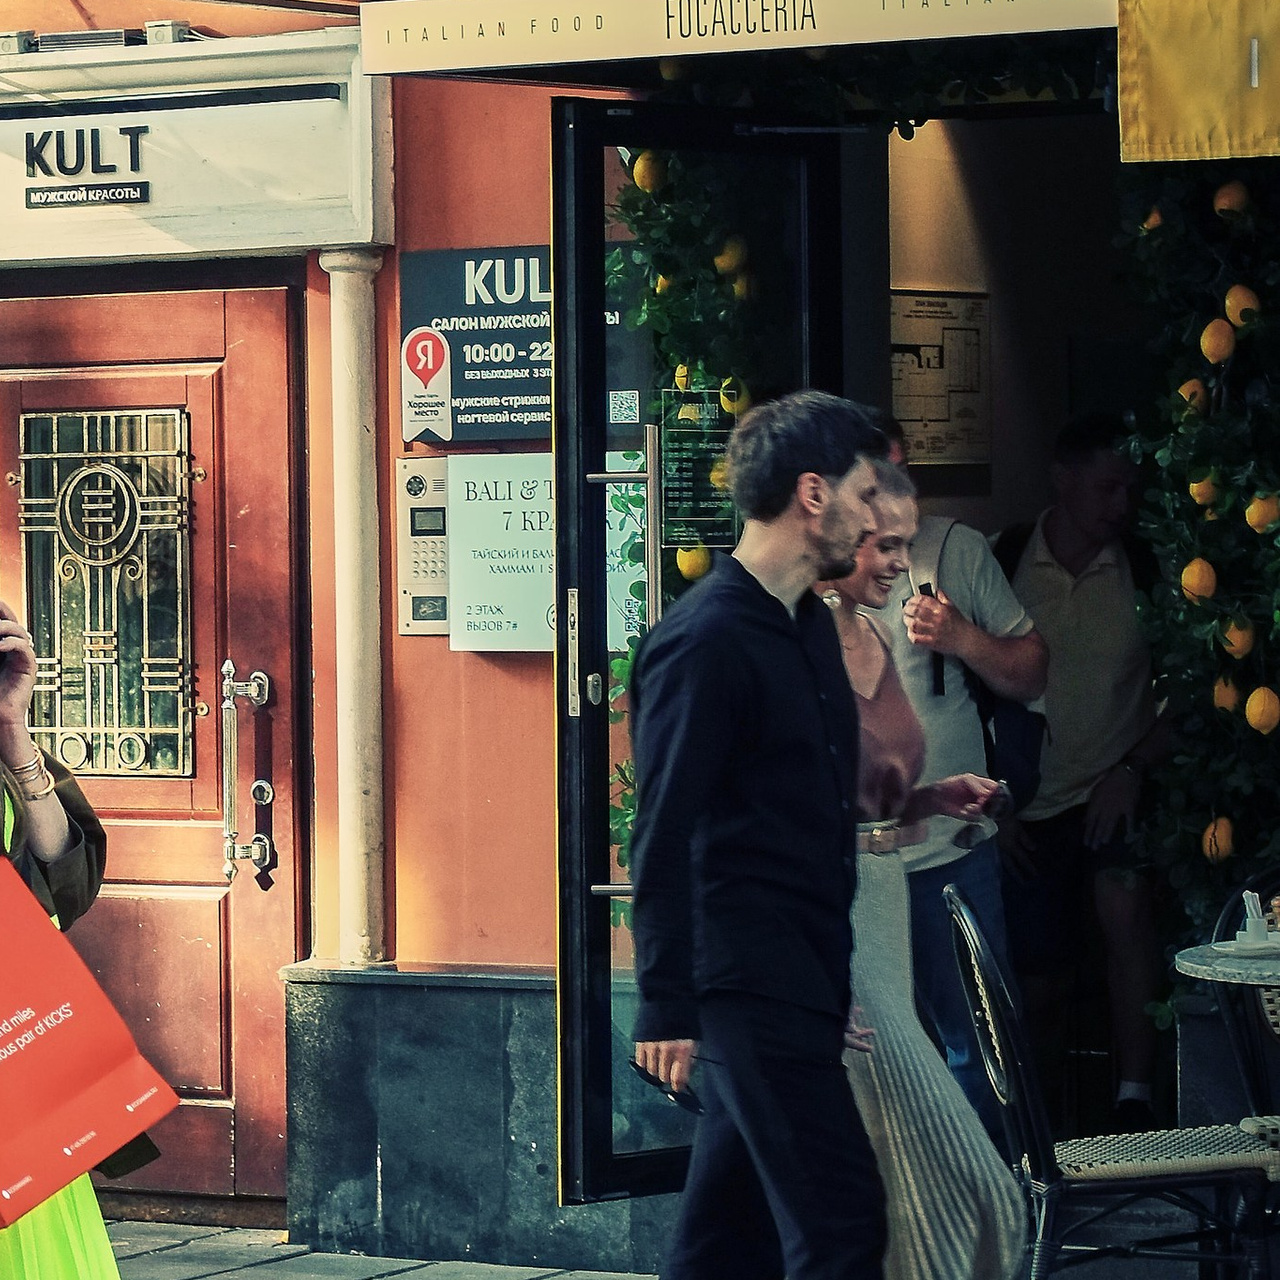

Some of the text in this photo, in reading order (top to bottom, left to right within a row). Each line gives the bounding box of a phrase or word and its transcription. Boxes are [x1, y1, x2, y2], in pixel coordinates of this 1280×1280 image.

[386, 15, 604, 44] ITALIAN FOOD
[25, 125, 149, 178] KULT
[30, 187, 141, 204] МУЖСКОЙ КРАСОТЫ
[464, 257, 552, 305] KUL
[431, 311, 550, 332] САЛОН МУЖСКОЙ
[463, 343, 515, 364] 10:00
[464, 370, 480, 380] БЕЗ
[481, 369, 529, 379] ВЫХОДНЫХ
[407, 400, 445, 410] Хорошее
[451, 395, 550, 410] мужские стрижки
[457, 411, 551, 425] ногтевой сервис
[465, 480, 513, 501] BALI
[520, 480, 538, 500] &
[502, 511, 513, 531] 7
[472, 548, 519, 559] ТАЙСКИЙ
[489, 564, 535, 573] ХАММАМ
[475, 605, 504, 615] ЭТАЖ
[466, 620, 503, 631] ВЫЗОВ
[10, 1007, 36, 1028] miles
[15, 1029, 36, 1050] pair
[34, 1018, 47, 1036] of
